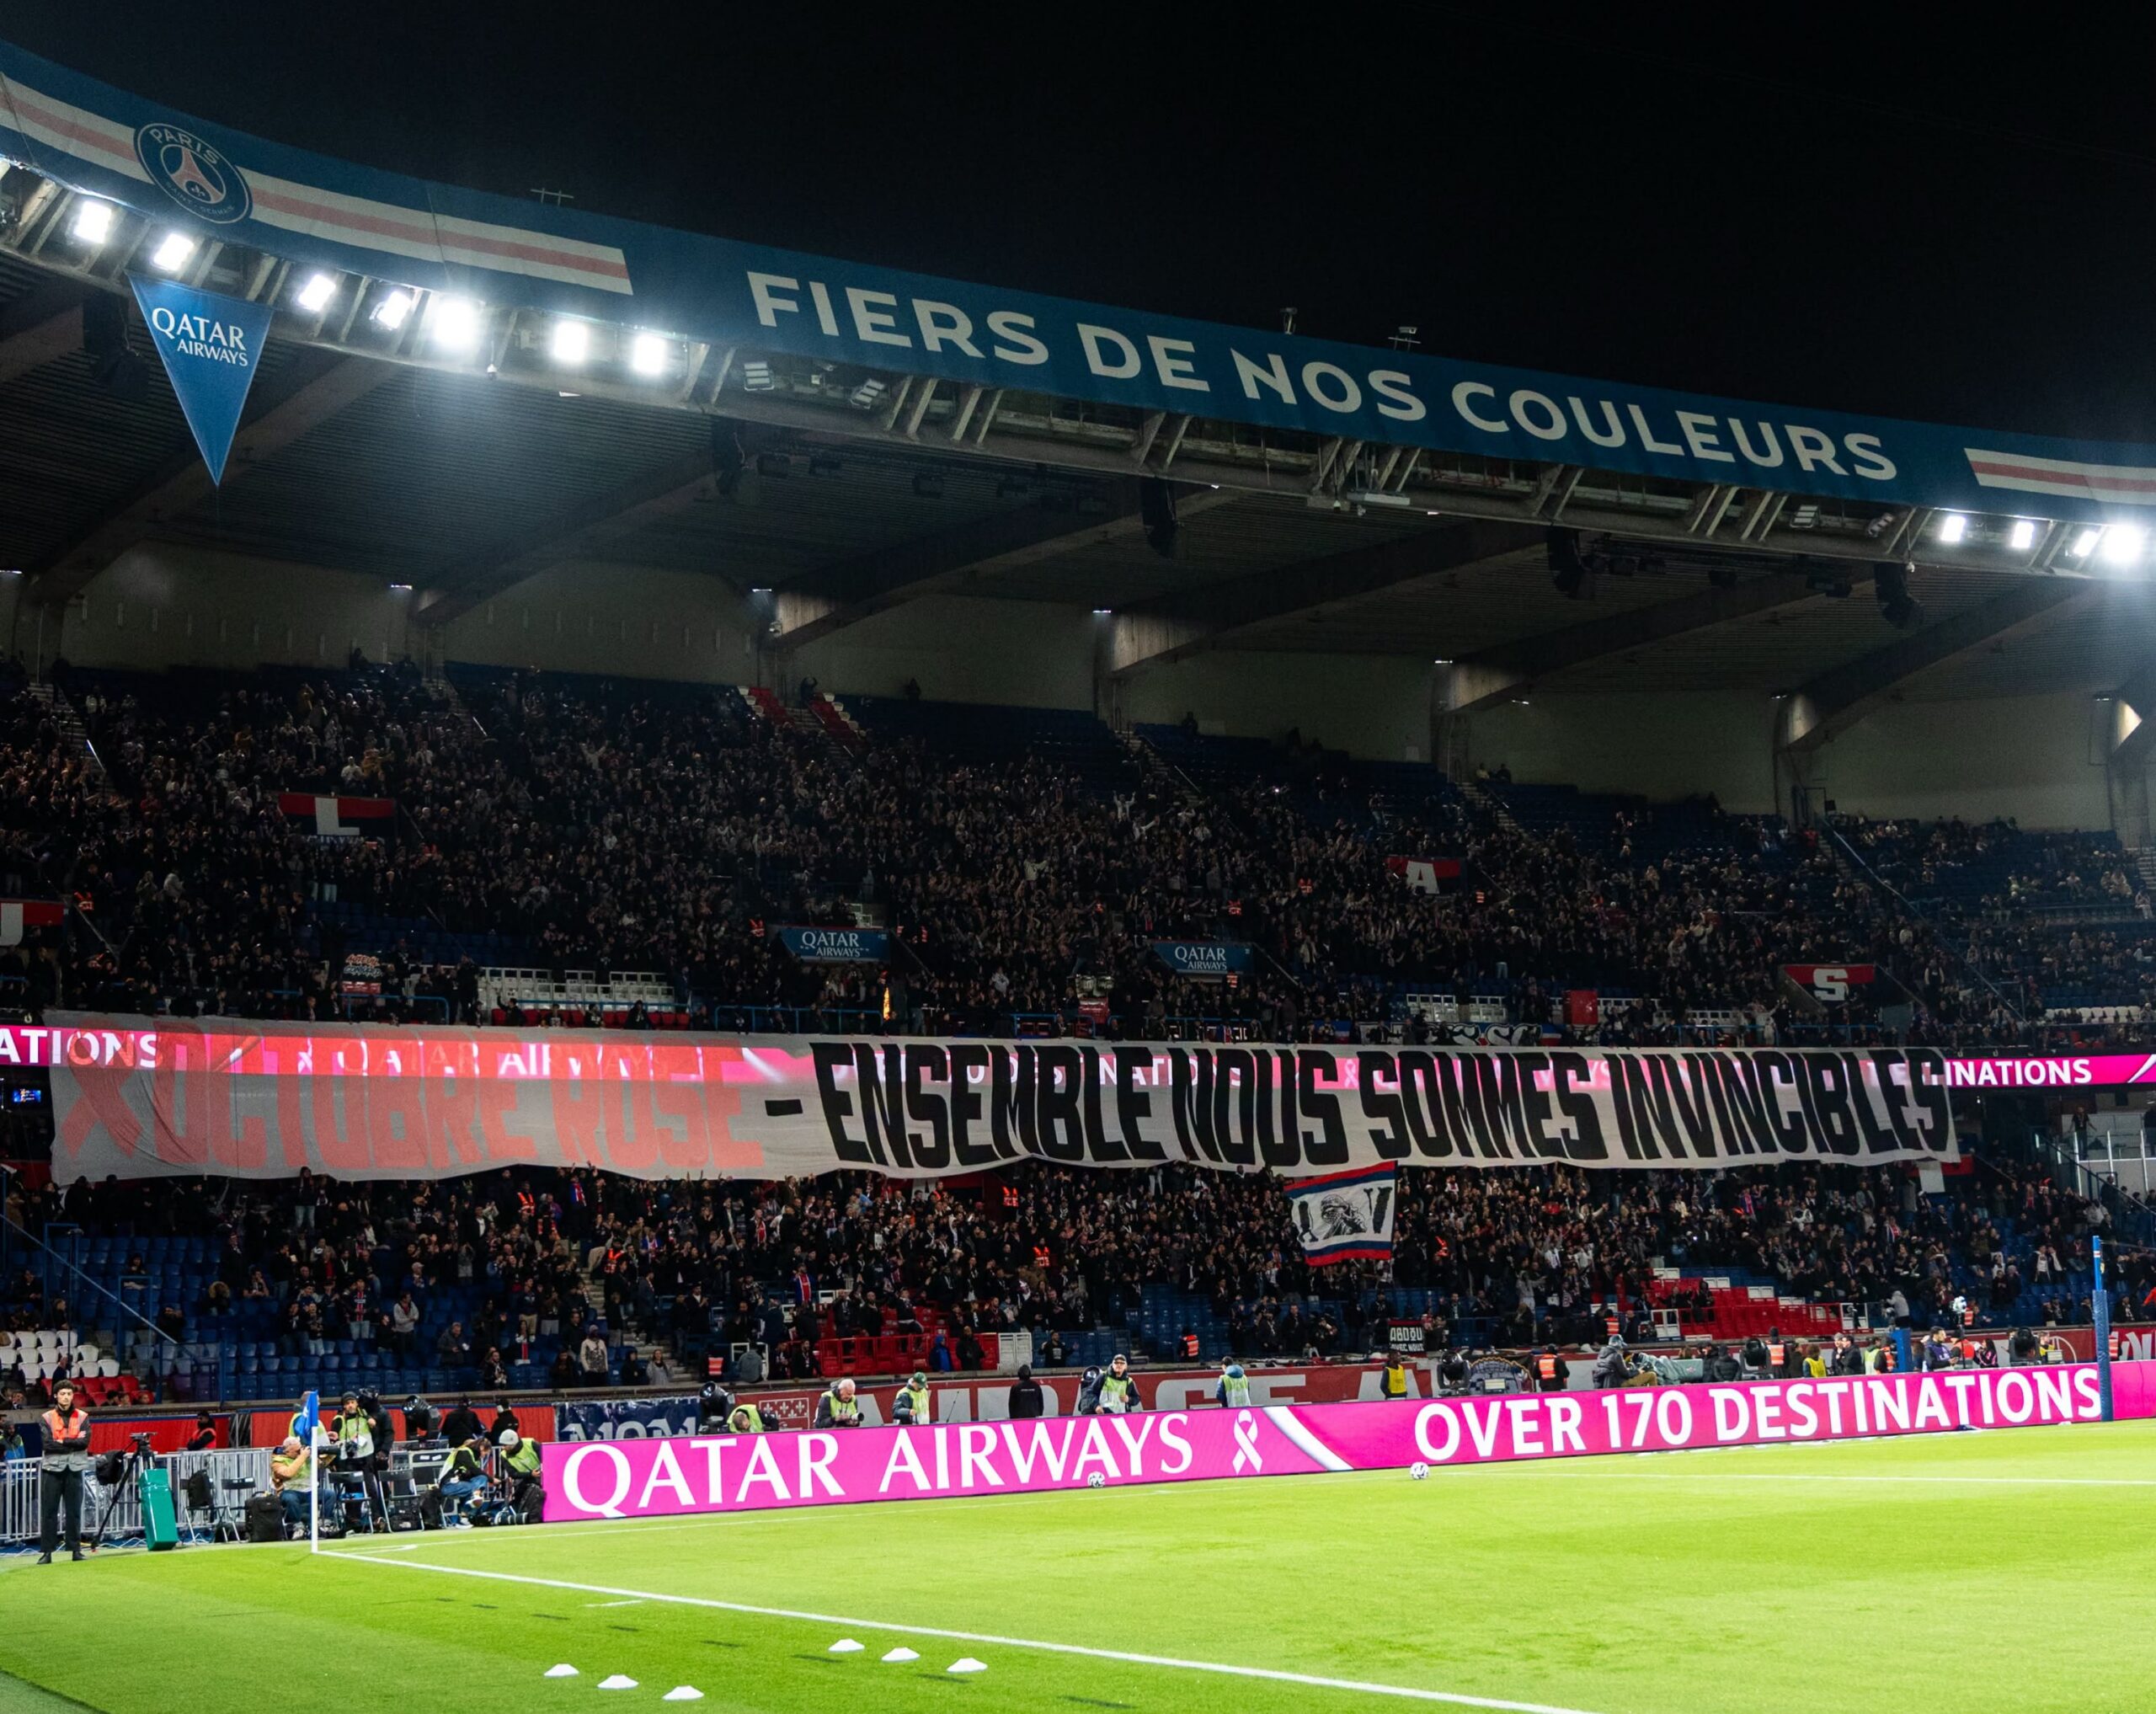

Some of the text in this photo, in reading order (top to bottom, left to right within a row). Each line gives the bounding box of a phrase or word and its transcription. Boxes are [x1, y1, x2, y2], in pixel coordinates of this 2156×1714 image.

[149, 128, 220, 164] PARIS
[152, 307, 246, 350] QATAR
[177, 339, 248, 367] AIRWAYS
[747, 271, 1897, 480] FIERS DE NOS COULEURS
[314, 797, 360, 836] L
[1406, 860, 1440, 894] A
[802, 931, 860, 948] QATAR
[816, 947, 861, 958] AIRWAYS
[1175, 946, 1226, 963] QATAR
[1187, 961, 1228, 971] AIRWAYS
[1813, 968, 1849, 1001] S
[152, 1020, 539, 1169] OCTOBRE
[547, 1036, 765, 1168] ROSE
[809, 1042, 1169, 1169] ENSEMBLE
[1167, 1047, 1349, 1167] NOUS
[1357, 1050, 1609, 1160] SOMMES
[1602, 1048, 1948, 1160] INVINCIBLES
[1390, 1327, 1423, 1342] ABDOU
[562, 1369, 2101, 1518] QATAR AIRWAYS OVER 170 DESTINATIONS
